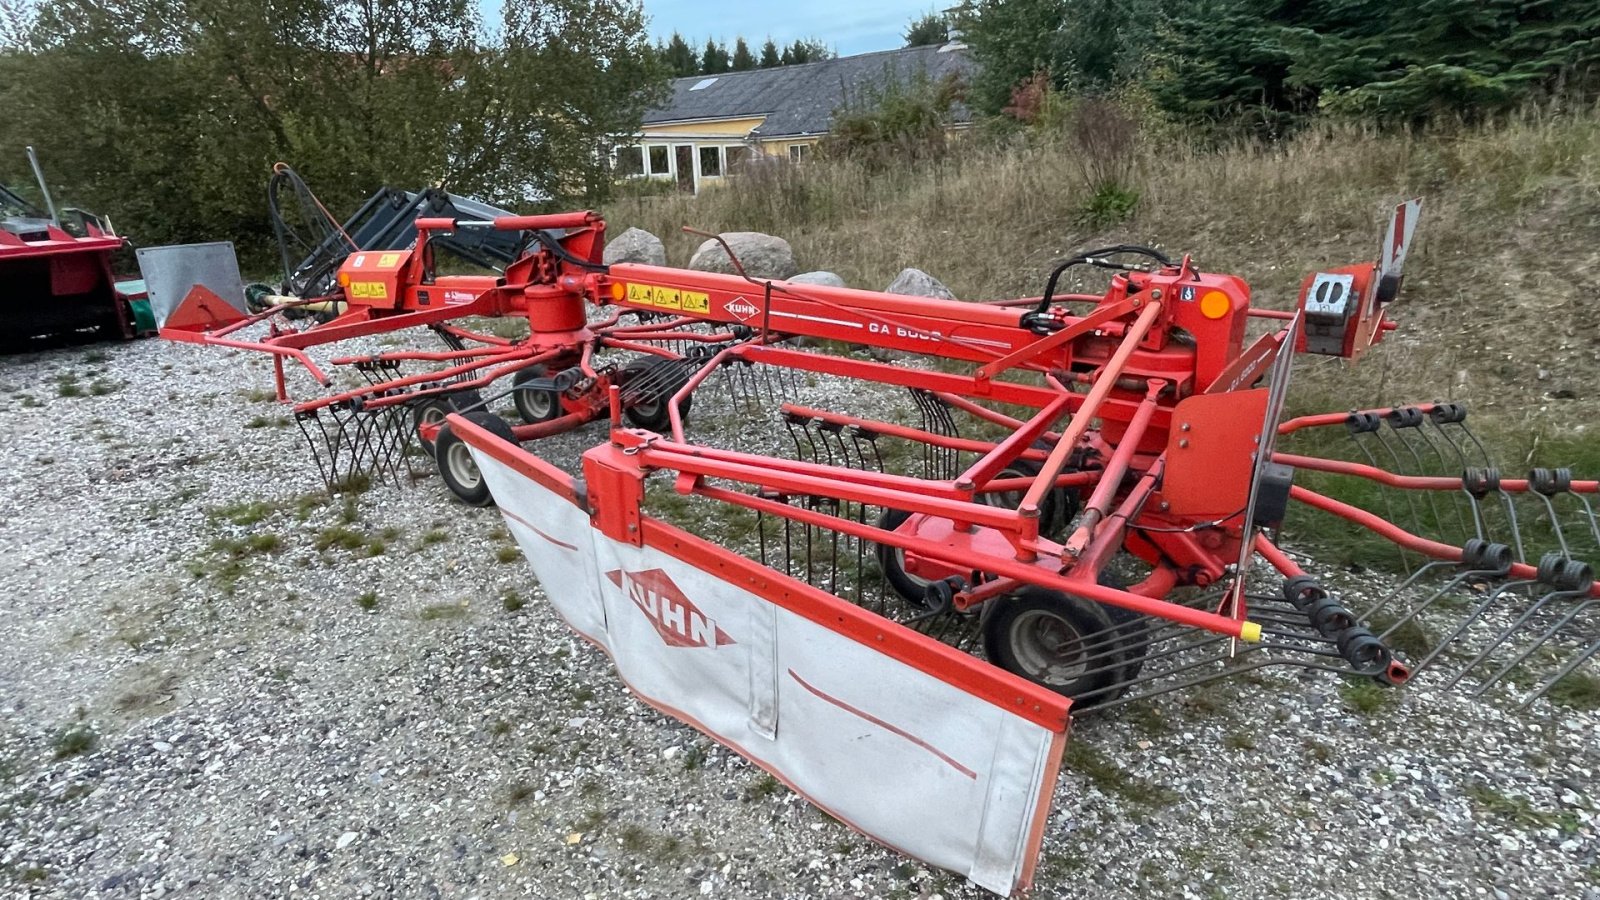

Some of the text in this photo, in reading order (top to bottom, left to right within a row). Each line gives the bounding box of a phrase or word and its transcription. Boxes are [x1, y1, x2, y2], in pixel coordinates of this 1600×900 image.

[728, 303, 756, 315] KUHN
[869, 322, 890, 335] GA
[621, 569, 717, 650] KUHN
